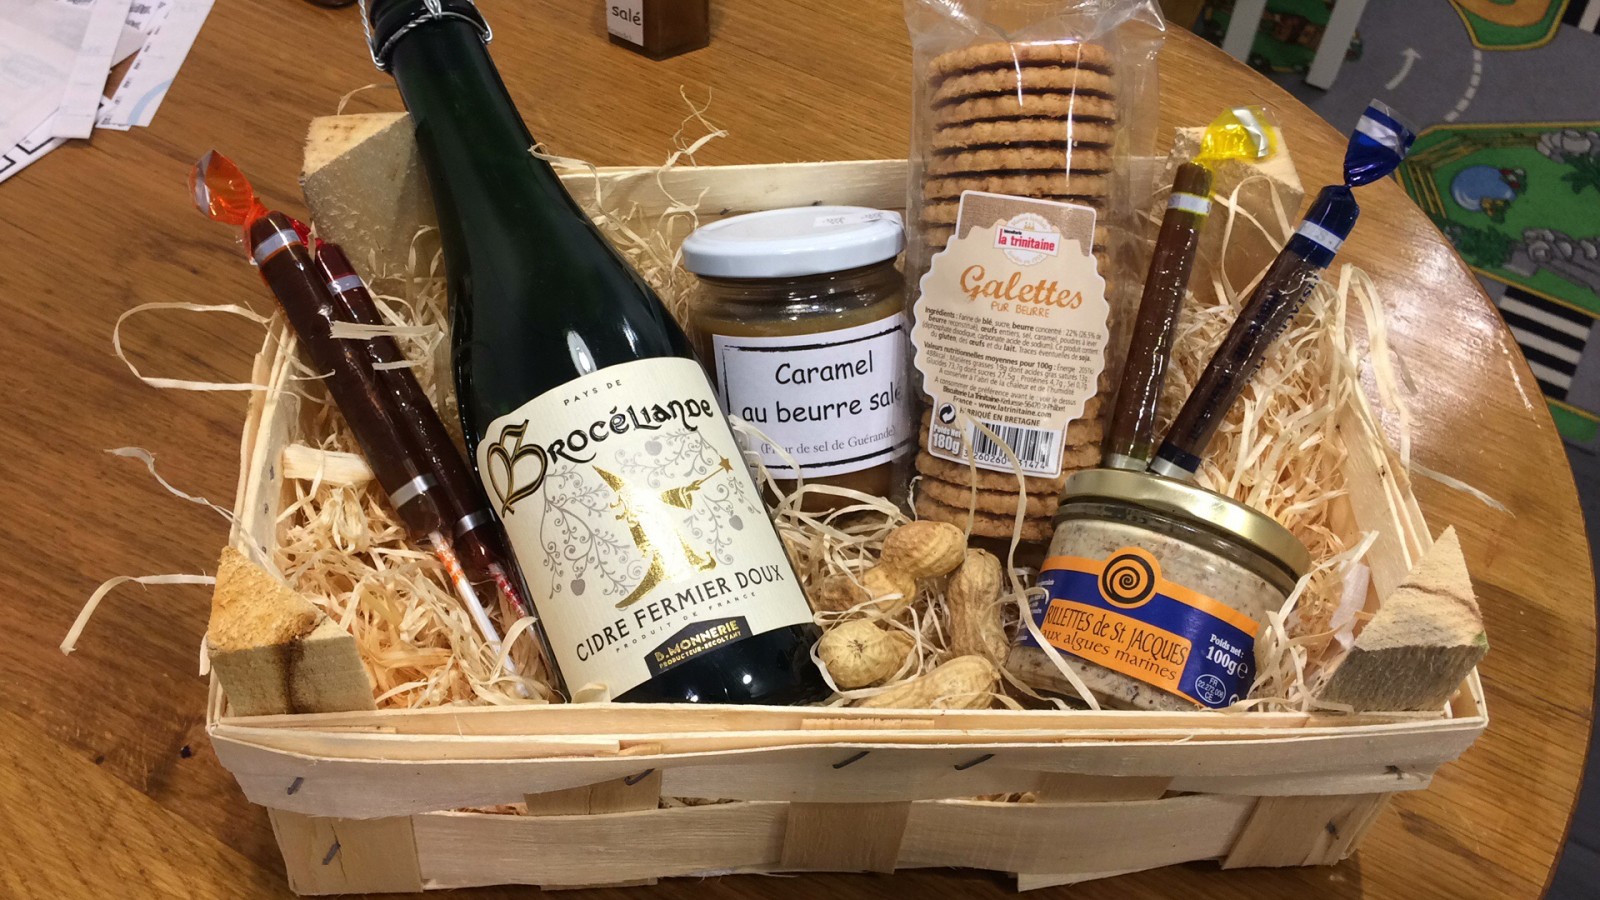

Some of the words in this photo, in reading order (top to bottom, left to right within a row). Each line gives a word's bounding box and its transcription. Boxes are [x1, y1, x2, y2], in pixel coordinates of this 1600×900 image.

[611, 6, 642, 26] salé
[998, 228, 1007, 245] la
[1010, 235, 1054, 251] trinitaine
[960, 264, 1082, 310] Galettes
[991, 301, 1010, 312] PUR
[1016, 304, 1050, 318] BEURRE
[1012, 322, 1034, 332] beurre
[924, 340, 942, 351] Valeurs
[985, 355, 1018, 366] moyennes
[1019, 360, 1035, 368] pour
[1019, 346, 1036, 355] Traces
[776, 350, 872, 385] Caramel
[972, 360, 994, 370] grasses
[1008, 366, 1023, 374] dont
[1024, 368, 1043, 376] acides
[978, 370, 996, 378] sucres
[564, 386, 598, 406] PAYS
[606, 379, 622, 390] DE
[1006, 381, 1028, 390] chaleur
[1010, 392, 1028, 400] avant
[742, 406, 767, 424] au
[776, 398, 862, 424] beurre
[953, 396, 972, 406] France
[978, 402, 1052, 418] www.latrinitaine.com
[934, 424, 950, 435] Poids
[1004, 416, 1040, 426] BRETAGNE
[796, 443, 810, 454] de
[814, 441, 828, 452] sel
[832, 440, 844, 450] de
[934, 433, 960, 454] 180g
[576, 618, 630, 662] CIDRE
[634, 577, 731, 628] FERMIER
[735, 564, 784, 589] DOUX
[616, 622, 672, 654] PRODUIT
[683, 612, 698, 620] DE
[708, 592, 756, 611] FRANCE
[1093, 614, 1110, 638] de
[1110, 622, 1125, 644] St.
[1126, 628, 1188, 666] JACQUES
[1210, 634, 1230, 650] Poids
[1064, 632, 1110, 656] algues
[1114, 647, 1177, 681] marines
[1208, 678, 1218, 687] FR
[1204, 692, 1214, 701] CE
